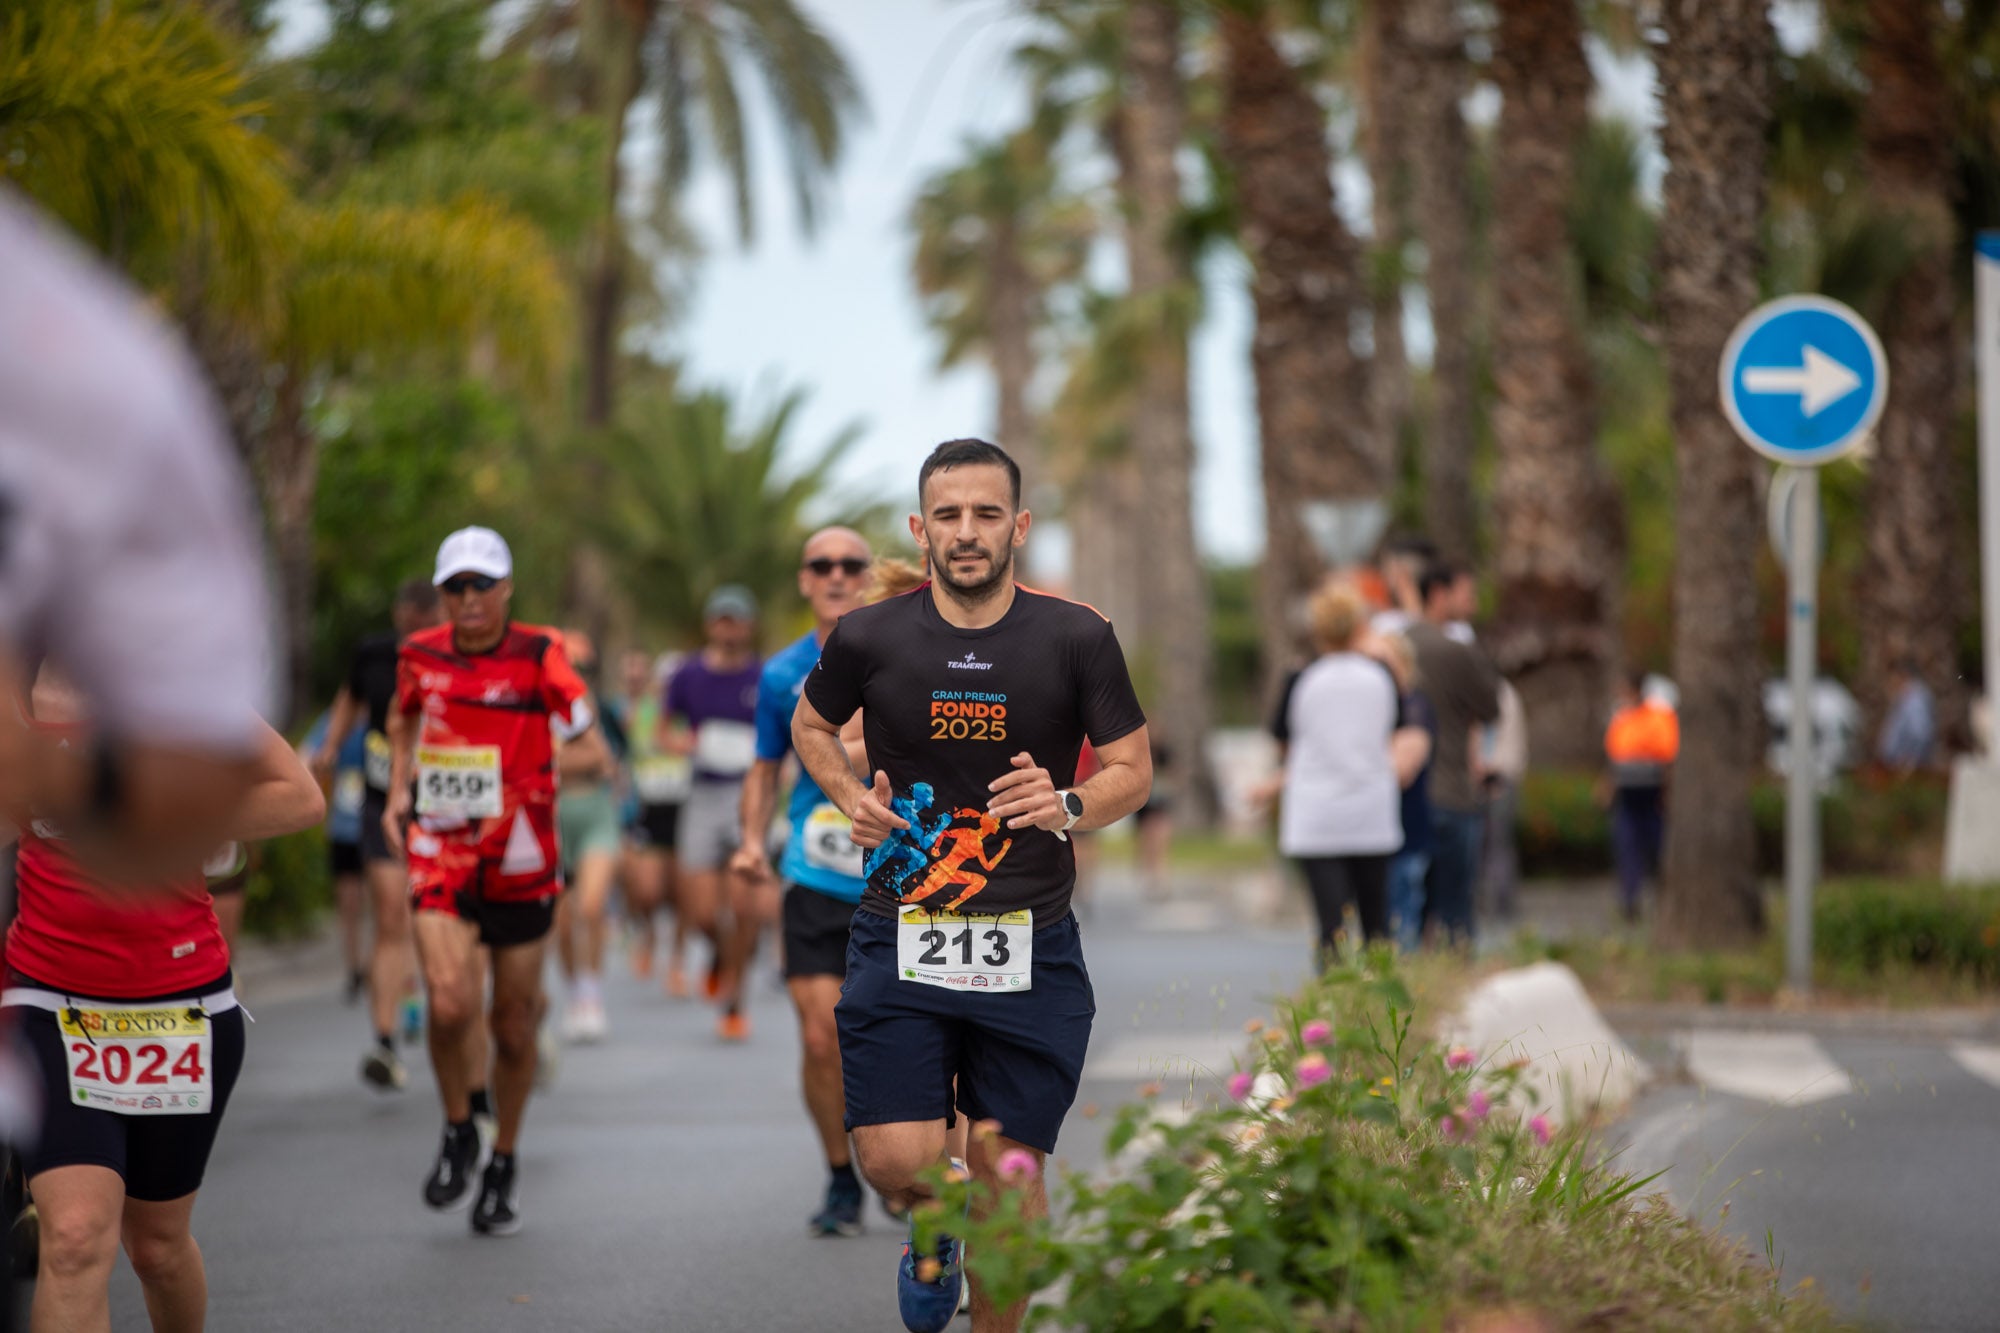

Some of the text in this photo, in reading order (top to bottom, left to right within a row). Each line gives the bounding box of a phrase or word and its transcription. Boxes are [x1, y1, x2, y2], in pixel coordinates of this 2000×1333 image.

[947, 661, 993, 670] TEAMERGY
[932, 690, 1007, 702] GRAN PREMIO
[930, 701, 1007, 719] FONDO
[930, 717, 1007, 741] 2025
[918, 929, 1010, 966] 213
[72, 1043, 204, 1085] 2024
